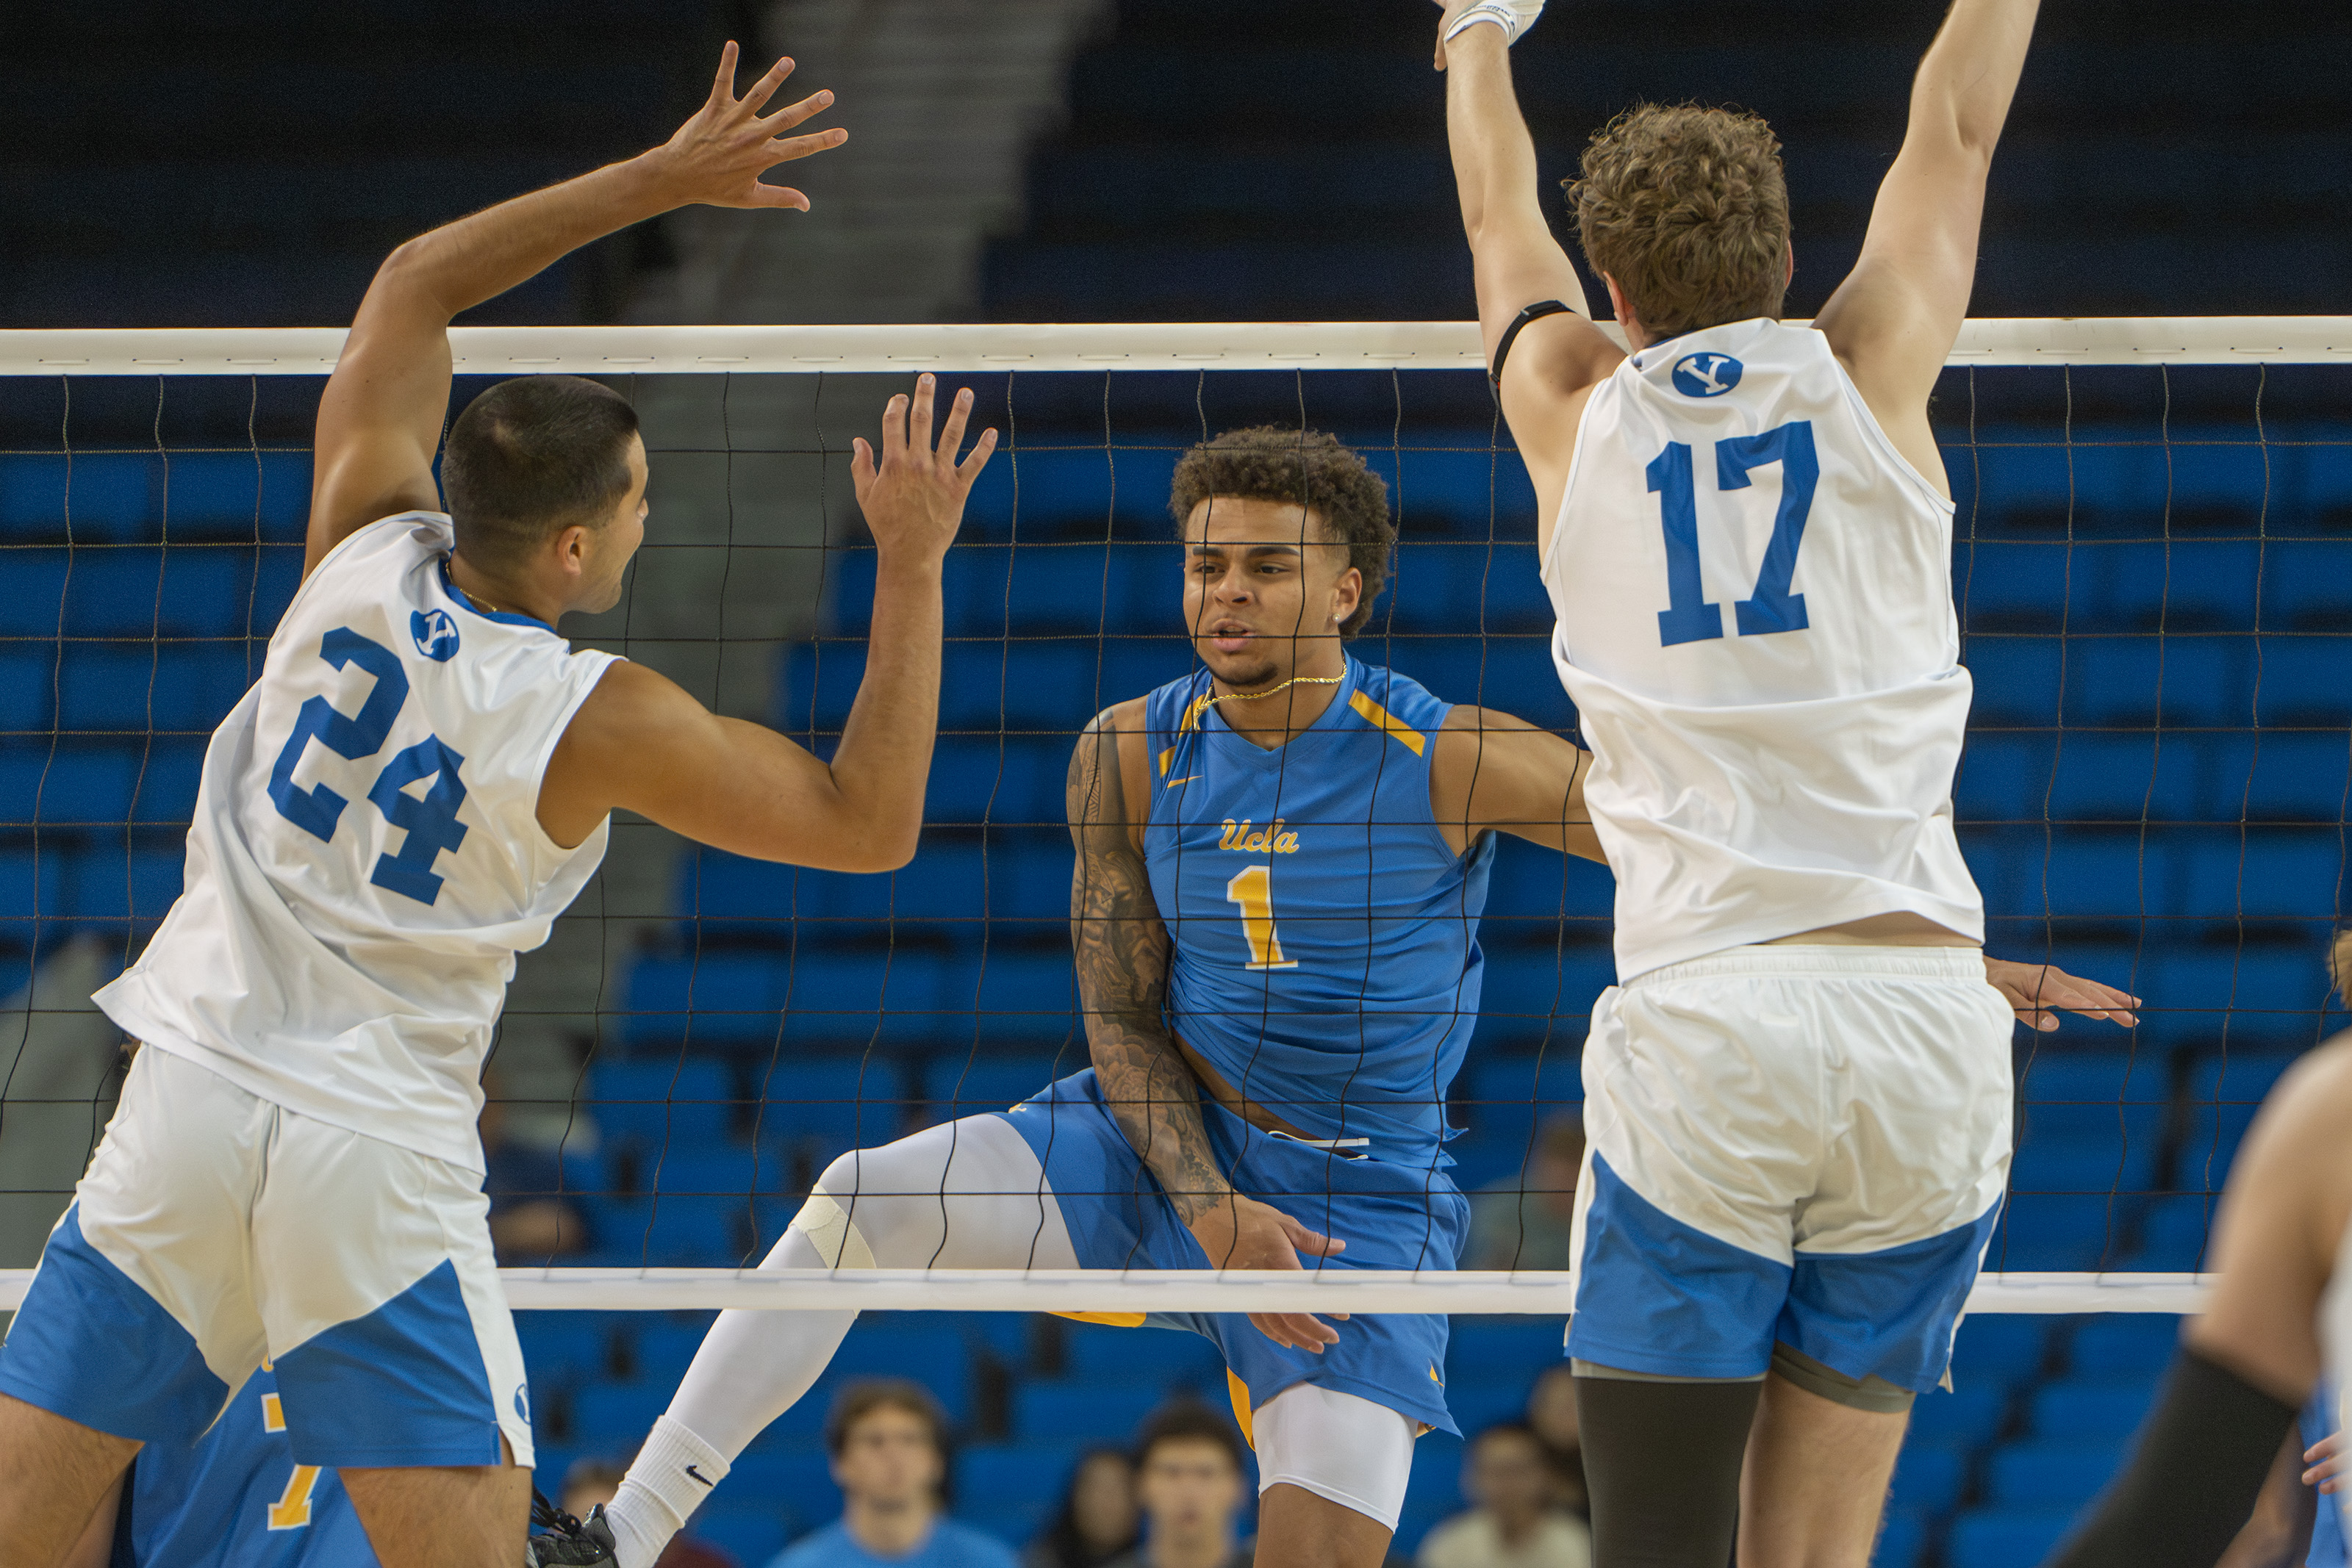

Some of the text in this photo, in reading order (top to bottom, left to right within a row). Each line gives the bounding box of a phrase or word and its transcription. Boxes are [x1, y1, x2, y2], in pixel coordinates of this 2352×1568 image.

[1676, 355, 1730, 395] Y
[1646, 420, 1820, 647] 17
[415, 611, 456, 655] Y
[268, 626, 469, 906] 24
[1219, 819, 1299, 854] Ucla
[1227, 865, 1299, 970] 1
